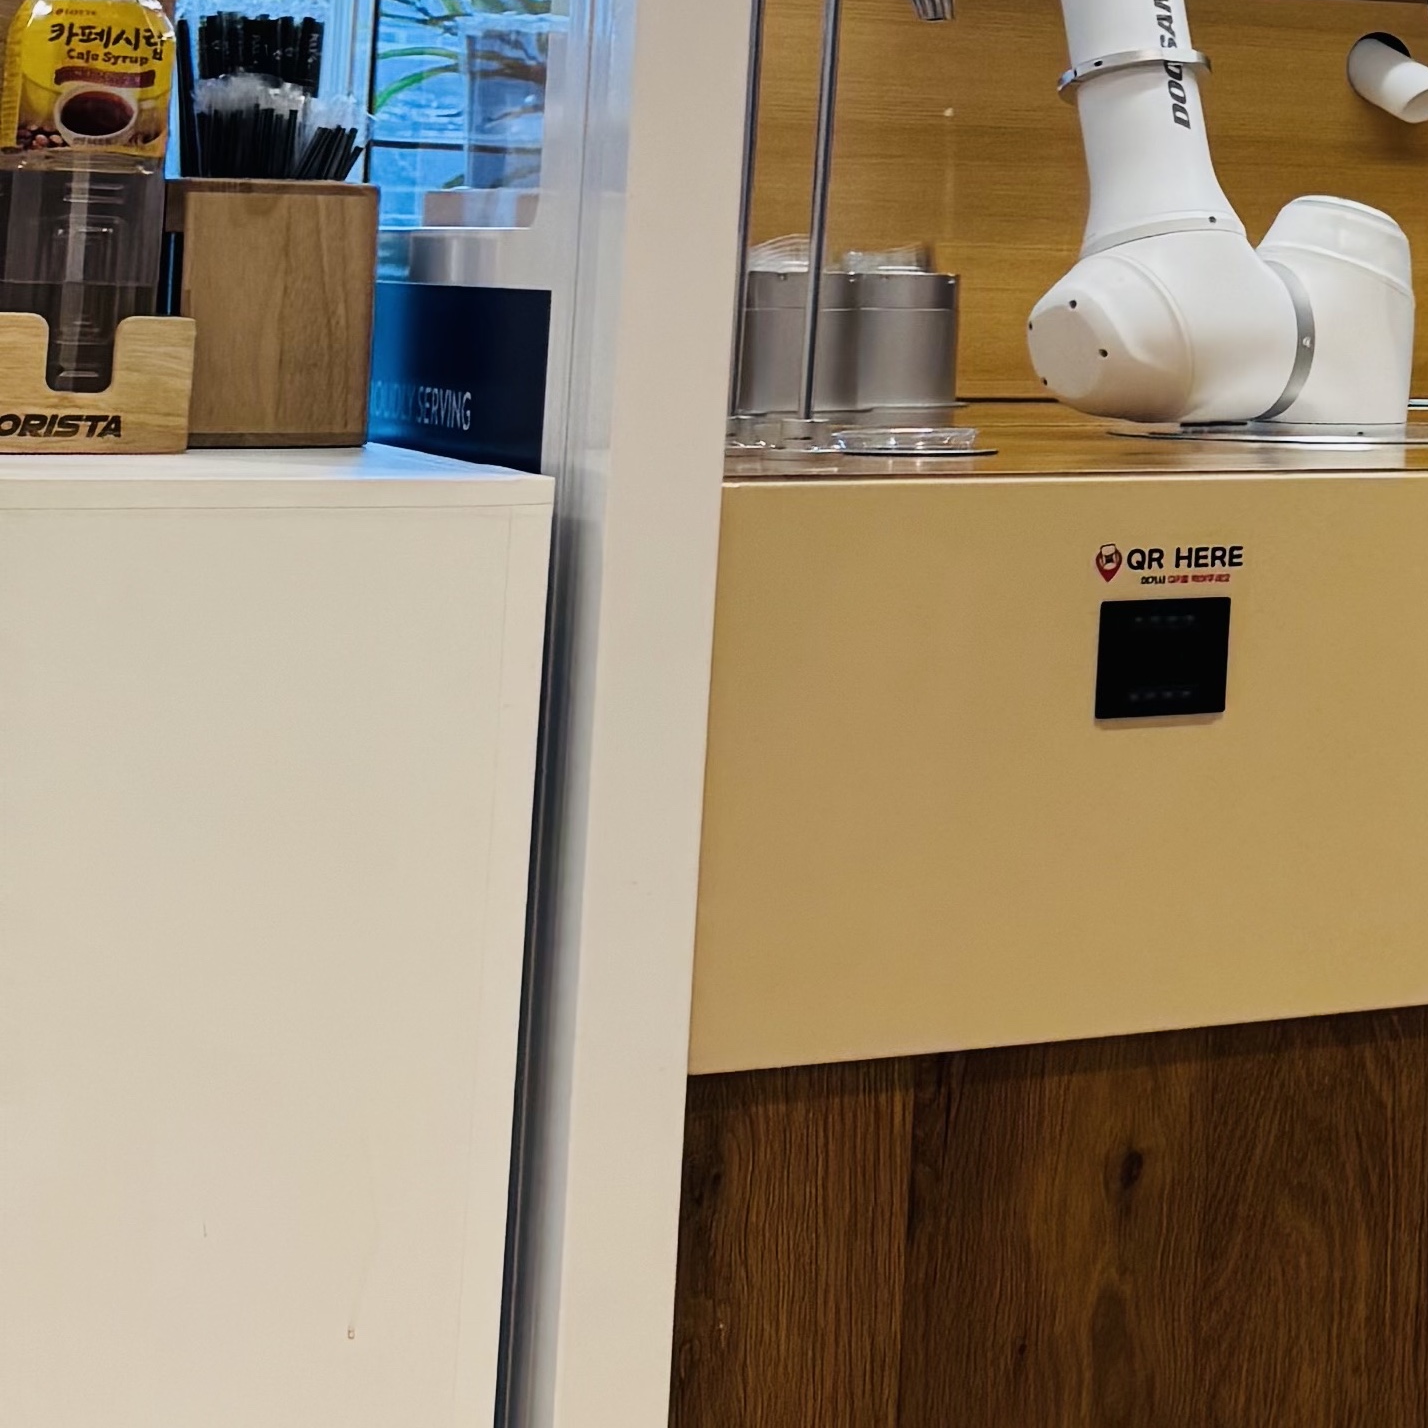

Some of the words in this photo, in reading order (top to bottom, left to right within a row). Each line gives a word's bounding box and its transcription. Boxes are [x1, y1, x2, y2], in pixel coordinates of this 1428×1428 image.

[48, 22, 164, 61] 카페시럽
[67, 48, 99, 63] Cafe
[102, 51, 149, 66] Syrup
[416, 386, 471, 431] SERVING
[1127, 548, 1164, 570] QR
[1174, 546, 1244, 568] HERE
